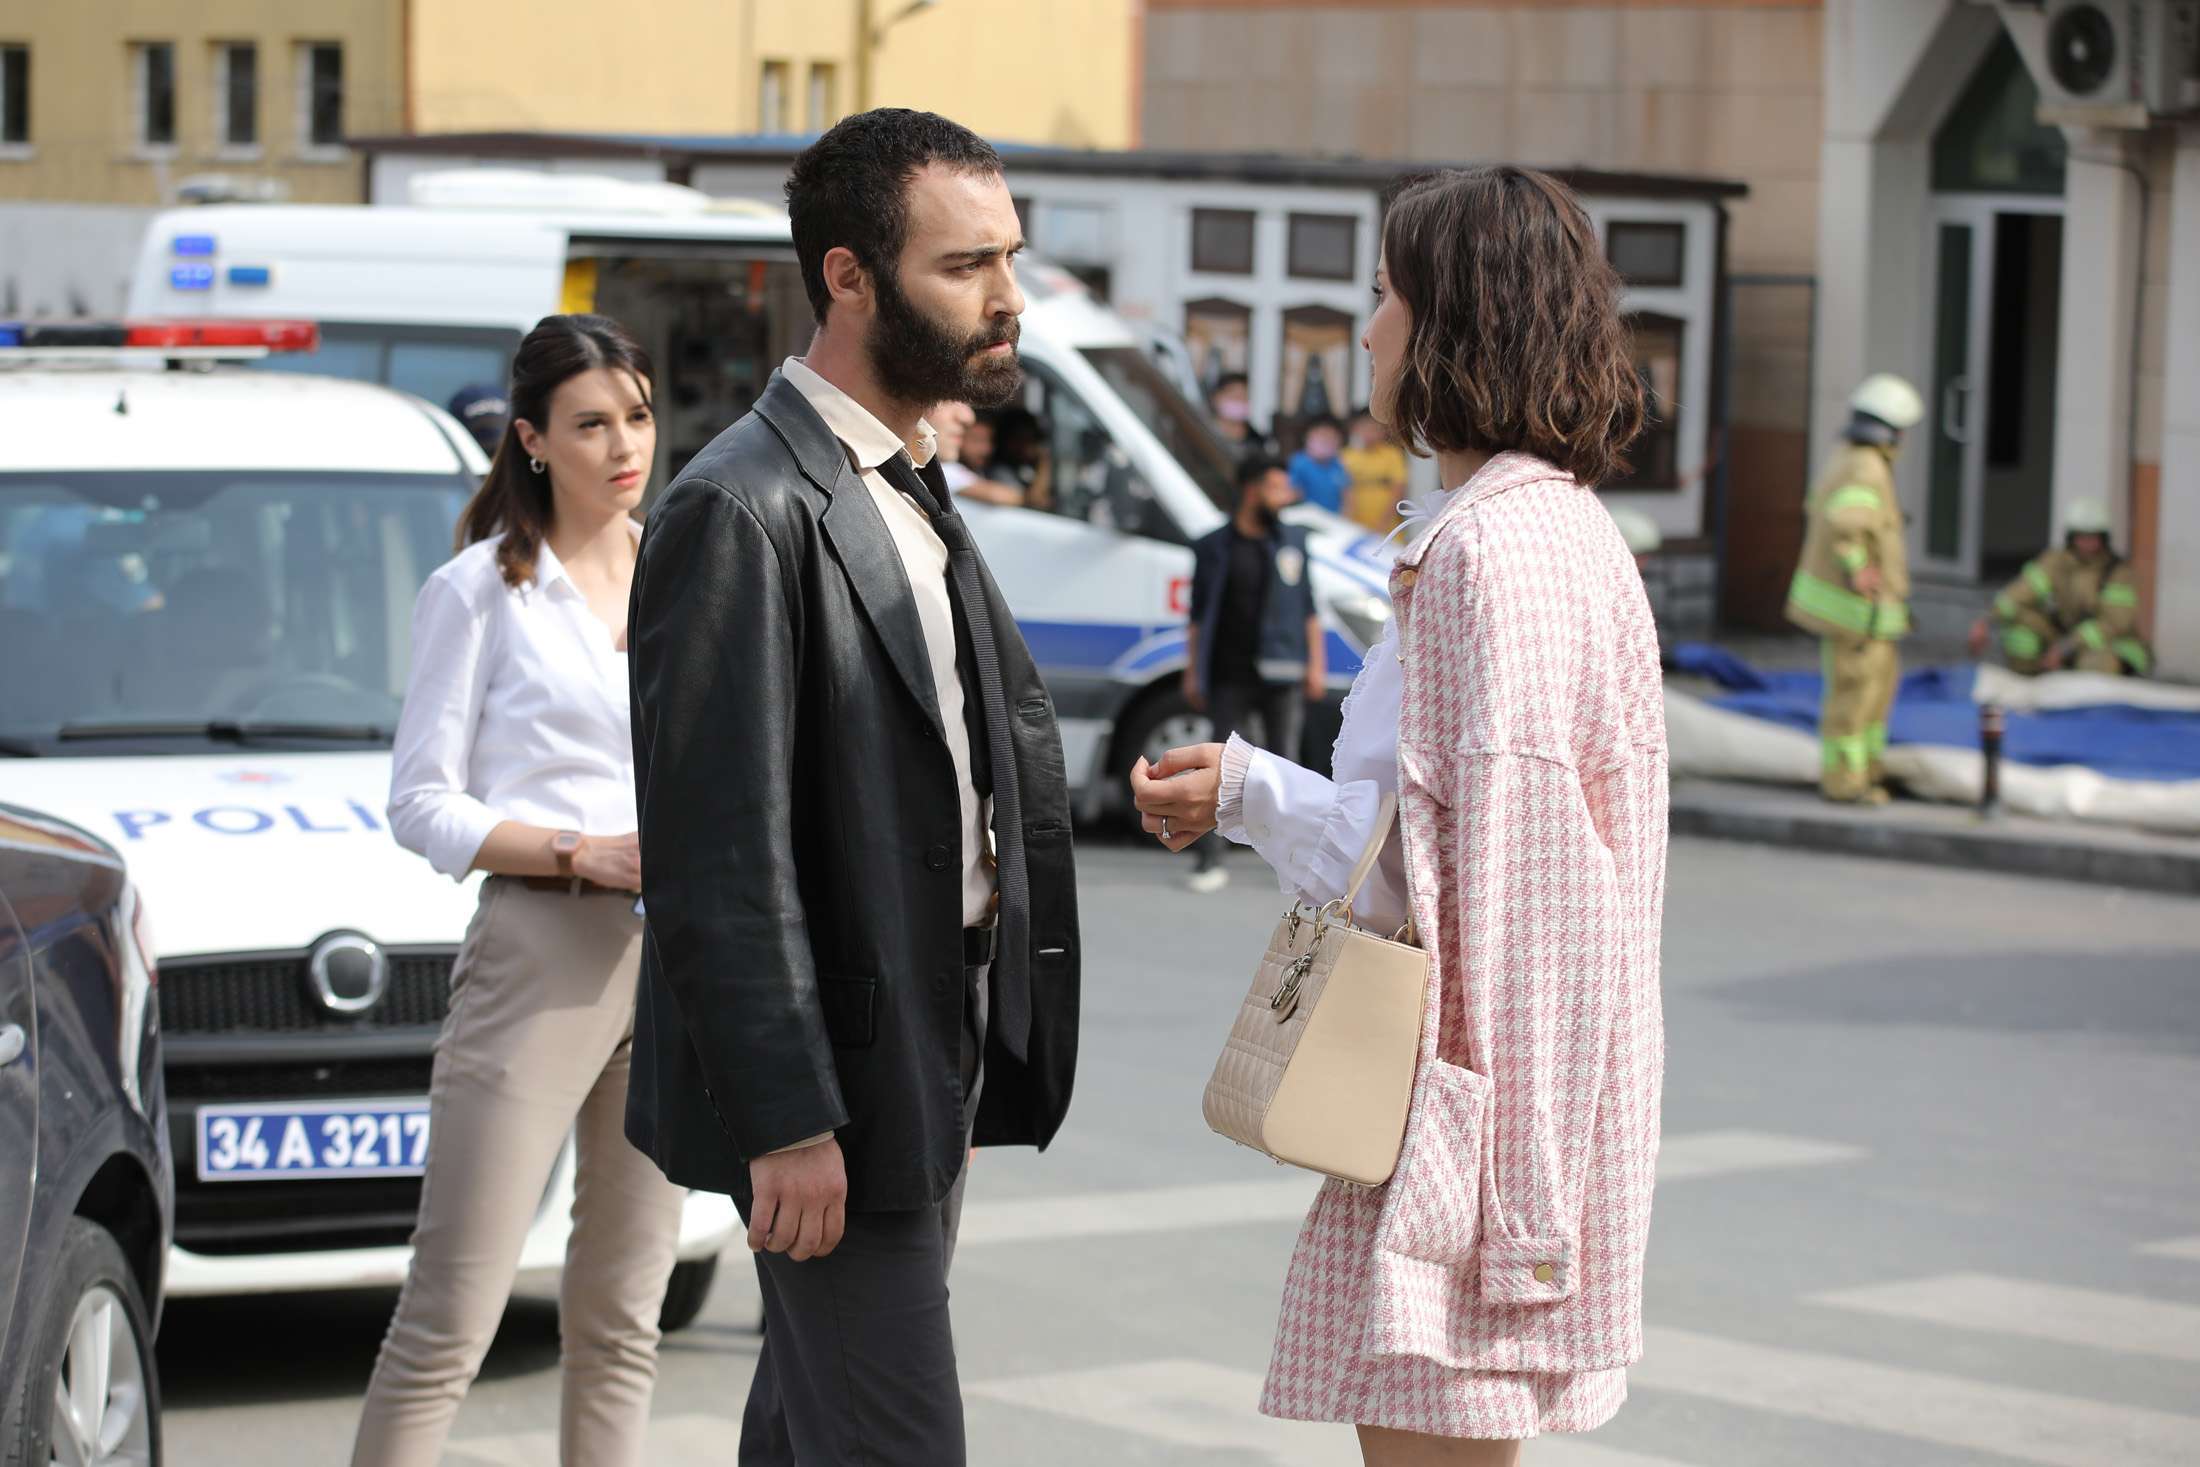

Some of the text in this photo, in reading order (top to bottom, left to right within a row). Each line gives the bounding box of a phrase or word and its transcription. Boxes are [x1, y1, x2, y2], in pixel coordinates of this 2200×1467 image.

[112, 797, 382, 840] POLİ
[209, 1114, 430, 1169] 34 A 3217
